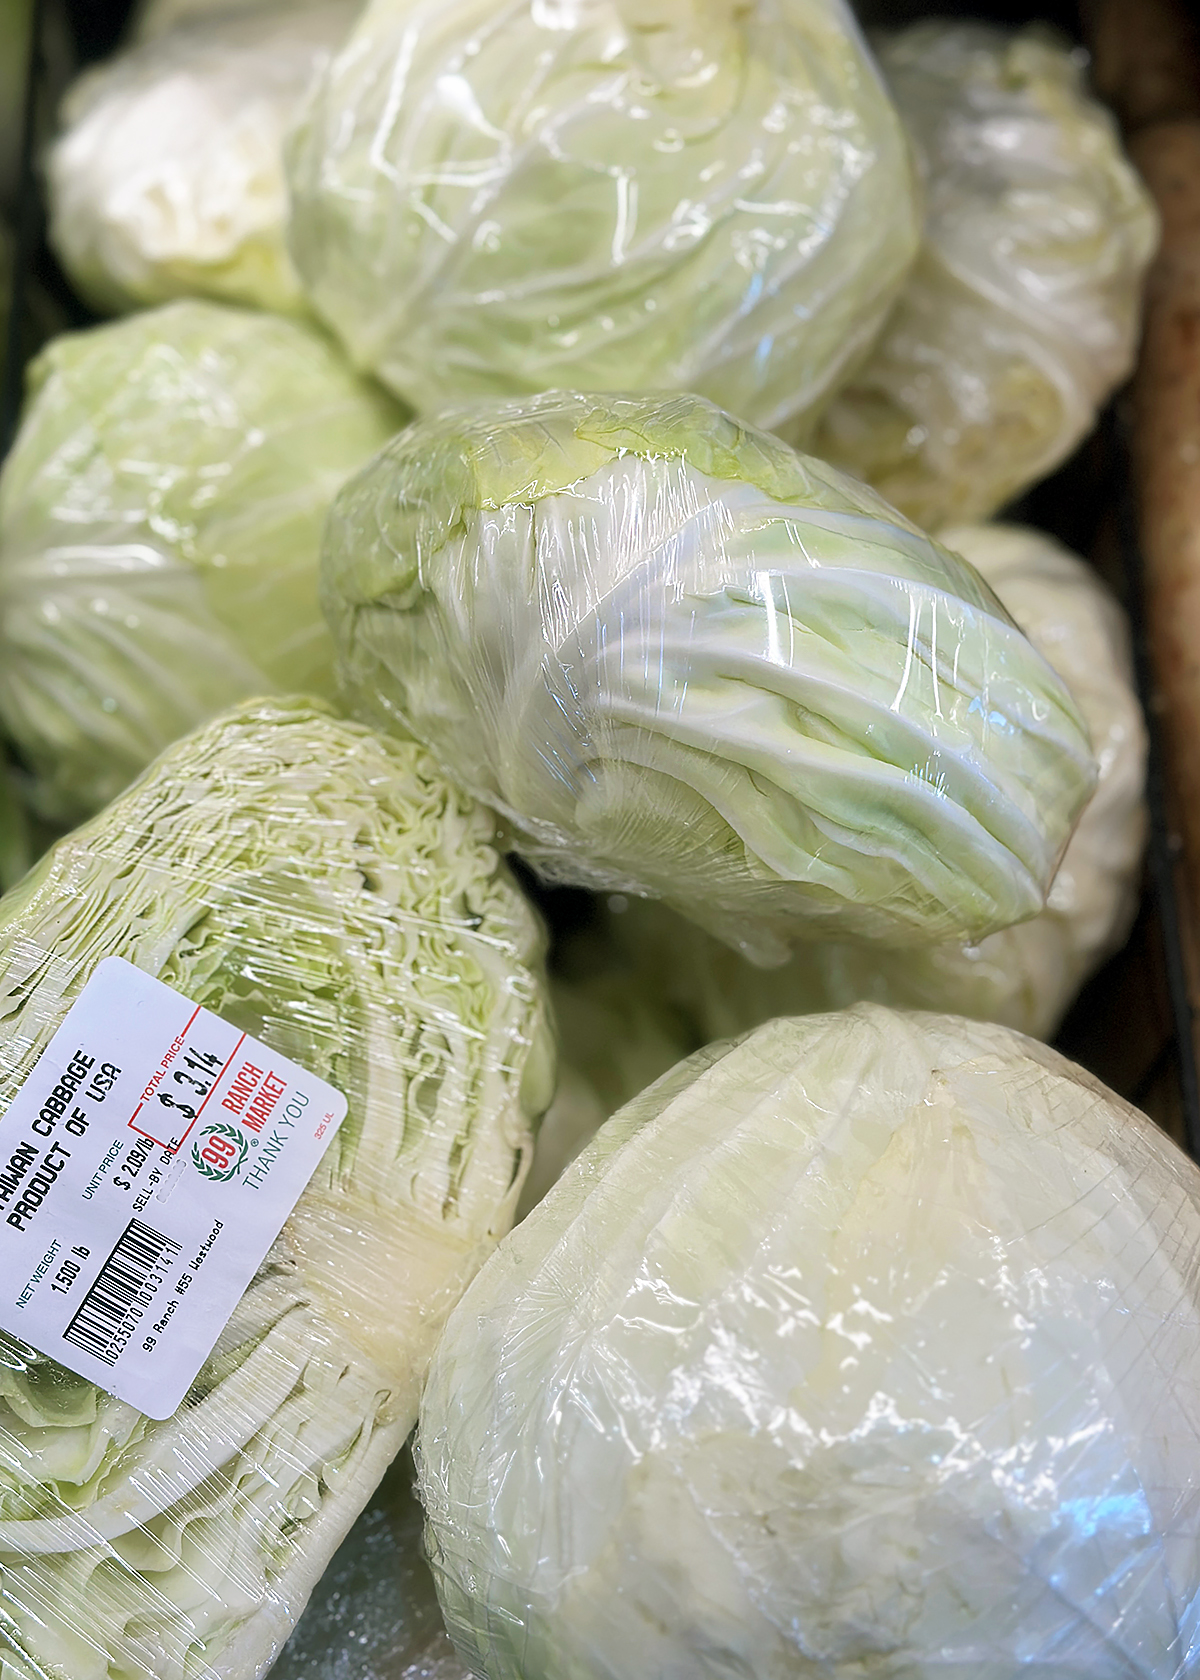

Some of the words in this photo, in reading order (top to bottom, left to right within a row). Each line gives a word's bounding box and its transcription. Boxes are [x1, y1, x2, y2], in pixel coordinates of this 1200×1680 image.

[140, 1069, 166, 1102] TOTAL
[161, 1036, 185, 1069] PRICE
[173, 1047, 224, 1096] 3.14
[222, 1061, 264, 1115] RANCH
[0, 1141, 39, 1210] AIWAN
[32, 1050, 96, 1137] CABBAGE
[157, 1093, 198, 1119] $
[241, 1070, 287, 1133] MARKET
[314, 1123, 327, 1140] 325
[323, 1112, 334, 1124] UL
[6, 1141, 71, 1232] PRODUCT
[65, 1107, 90, 1137] OF
[85, 1063, 122, 1102] USA
[82, 1172, 104, 1200] UNIT
[99, 1139, 124, 1175] PRICE
[121, 1137, 155, 1178] 2.09/lb
[201, 1135, 236, 1169] 99
[242, 1130, 288, 1190] THANK
[278, 1091, 309, 1128] YOU
[113, 1176, 131, 1190] $
[132, 1167, 163, 1212] SELL-BY
[159, 1137, 182, 1166] DATE
[15, 1283, 35, 1308] NET
[30, 1239, 62, 1284] WEIGHT
[51, 1259, 81, 1294] 1.500
[70, 1245, 91, 1260] lb
[142, 1336, 157, 1352] 99
[153, 1299, 179, 1333] Ranch
[174, 1273, 193, 1295] #55
[188, 1219, 224, 1270] Westwood
